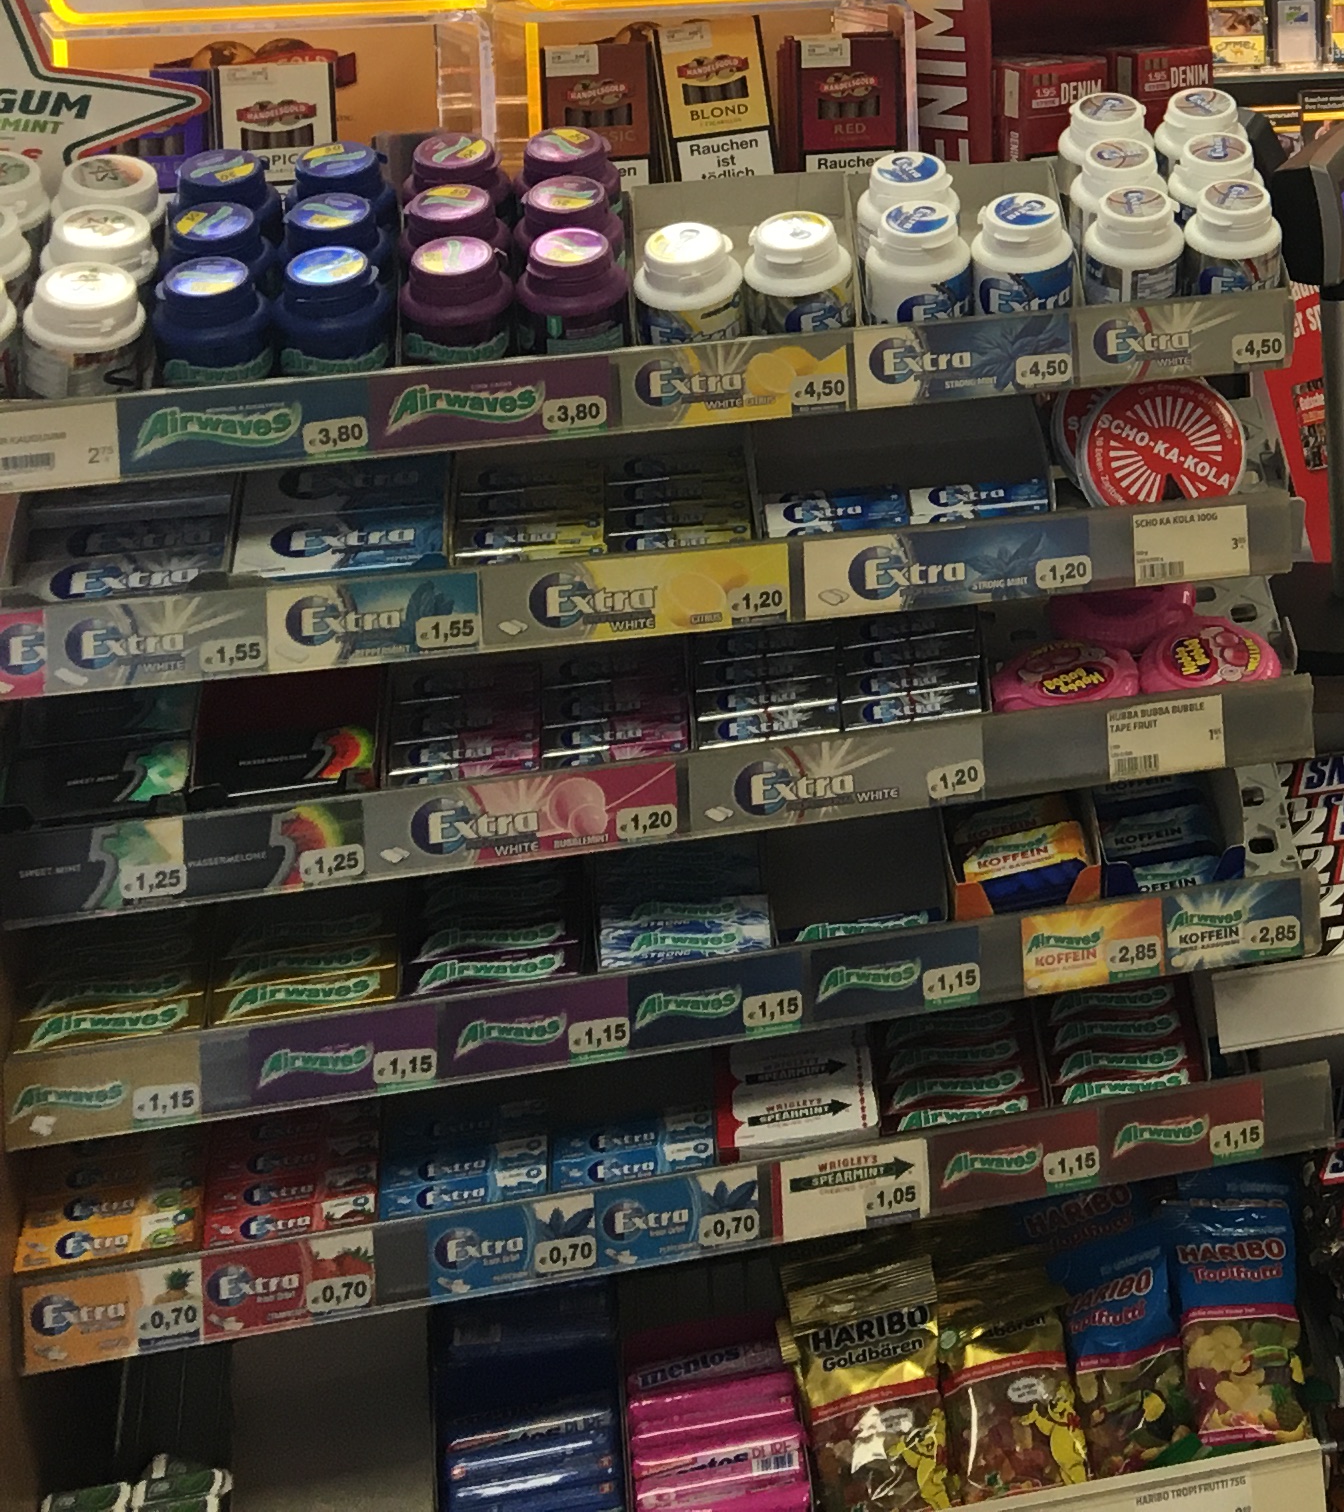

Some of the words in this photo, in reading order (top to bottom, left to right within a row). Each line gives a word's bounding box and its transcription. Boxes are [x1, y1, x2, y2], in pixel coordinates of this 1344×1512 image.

[688, 100, 750, 121] BLOND
[882, 347, 973, 379] Extra
[138, 406, 293, 441] Airwaves
[1100, 411, 1232, 490] SCHO-KA-KOLA
[1134, 517, 1158, 530] SCHO
[1160, 516, 1172, 527] KA
[1174, 515, 1196, 526] KOLA
[1109, 711, 1140, 724] HUBBA
[1143, 707, 1171, 720] BUBBA
[1174, 701, 1206, 715] BUBBLE
[1109, 720, 1130, 734] TAPE
[1133, 718, 1159, 731] FRUIT
[750, 770, 854, 806] Extra
[857, 787, 899, 802] WHITE
[811, 1303, 929, 1354] HARIBO
[822, 1334, 924, 1373] Goldbären
